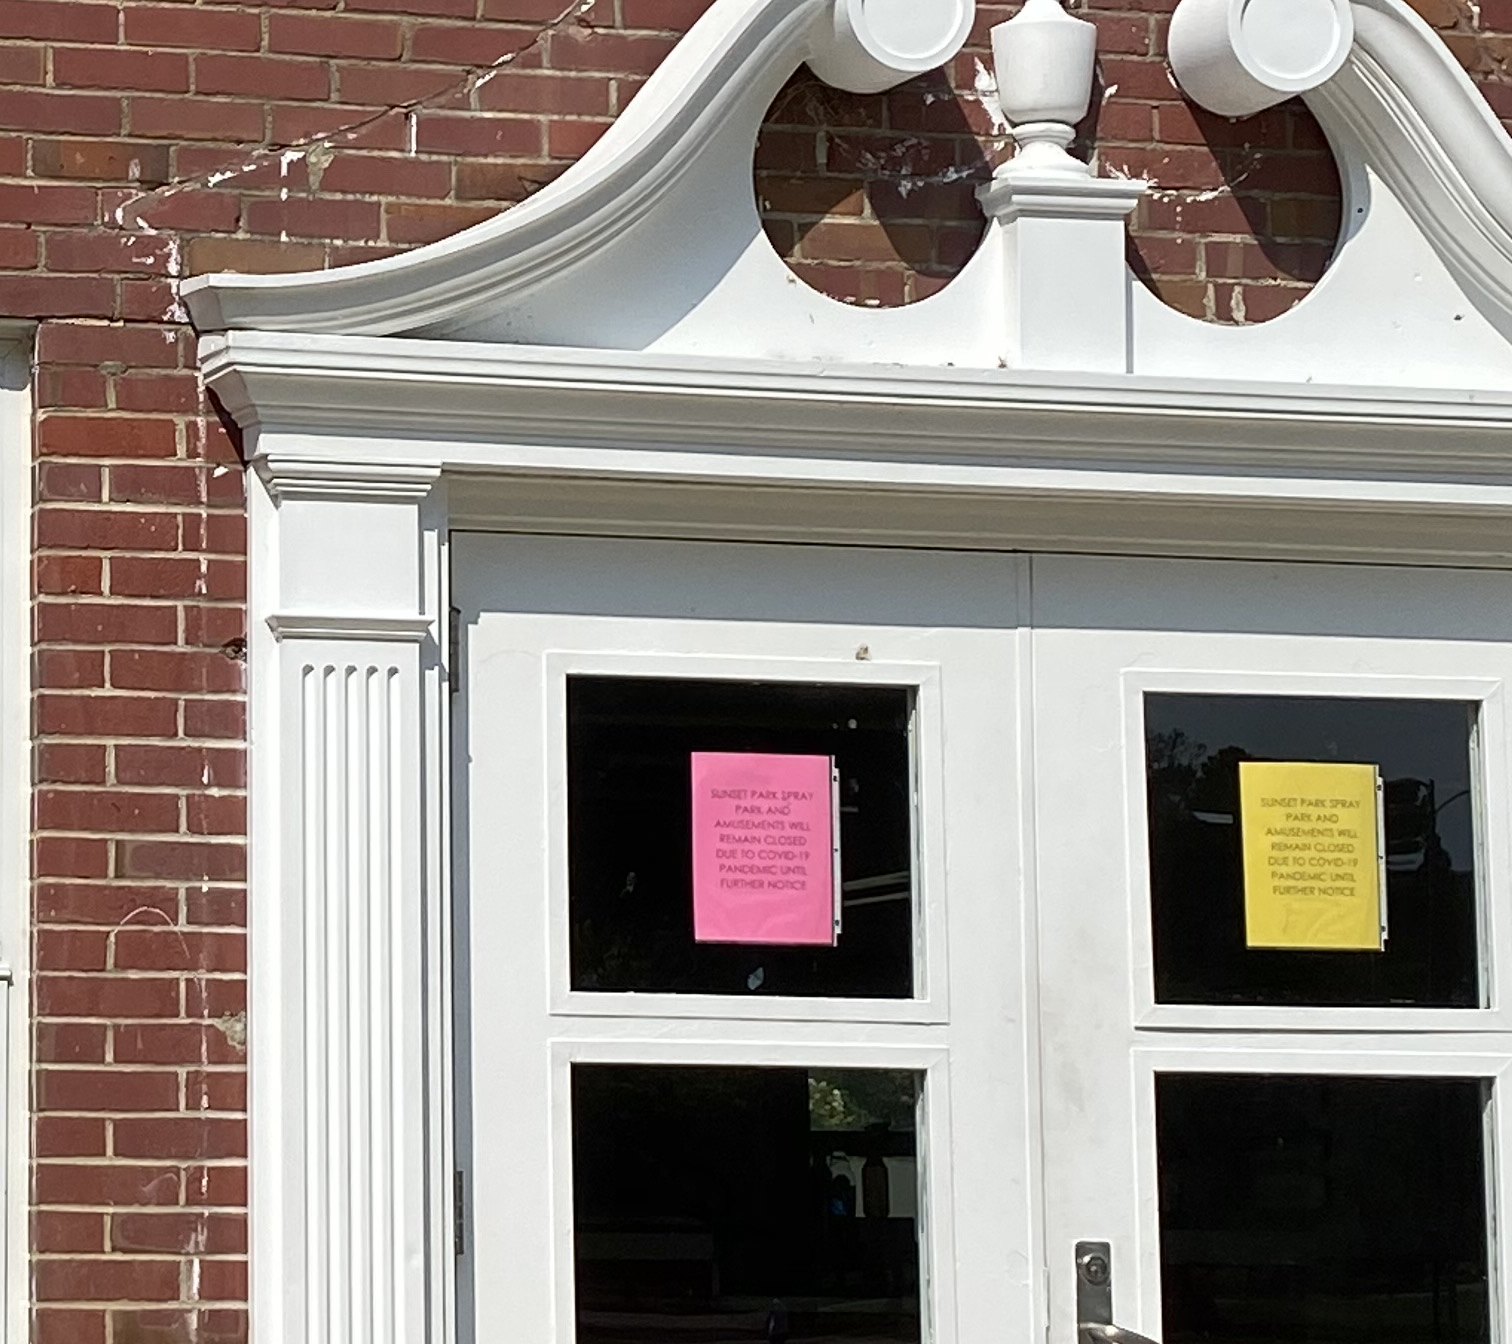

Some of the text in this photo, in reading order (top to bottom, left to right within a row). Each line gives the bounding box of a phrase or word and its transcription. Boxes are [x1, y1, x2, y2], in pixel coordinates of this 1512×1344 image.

[711, 789, 814, 801] SUNSET PARK SPRAY
[1261, 798, 1361, 809] SUNSET PARK SPRAY
[735, 805, 790, 815] PARK AND
[1286, 813, 1339, 822] PARK AND
[714, 820, 812, 831] AMUSEMENTS WILL
[1265, 827, 1358, 838] AMUSEMENTS WILL
[719, 834, 807, 846] REMAIN CLOSED
[1271, 842, 1355, 853] REMAIN CLOSED
[716, 849, 737, 860] DUE
[740, 850, 755, 860] TO
[1268, 856, 1289, 866] DUE
[1292, 857, 1306, 866] TO
[719, 864, 807, 876] PANDEMIC UNTIL
[1271, 871, 1357, 883] PANDEMIC UNTIL
[720, 878, 807, 890] FURTHER NOTICE
[1273, 885, 1356, 897] FURTHER NOTICE
